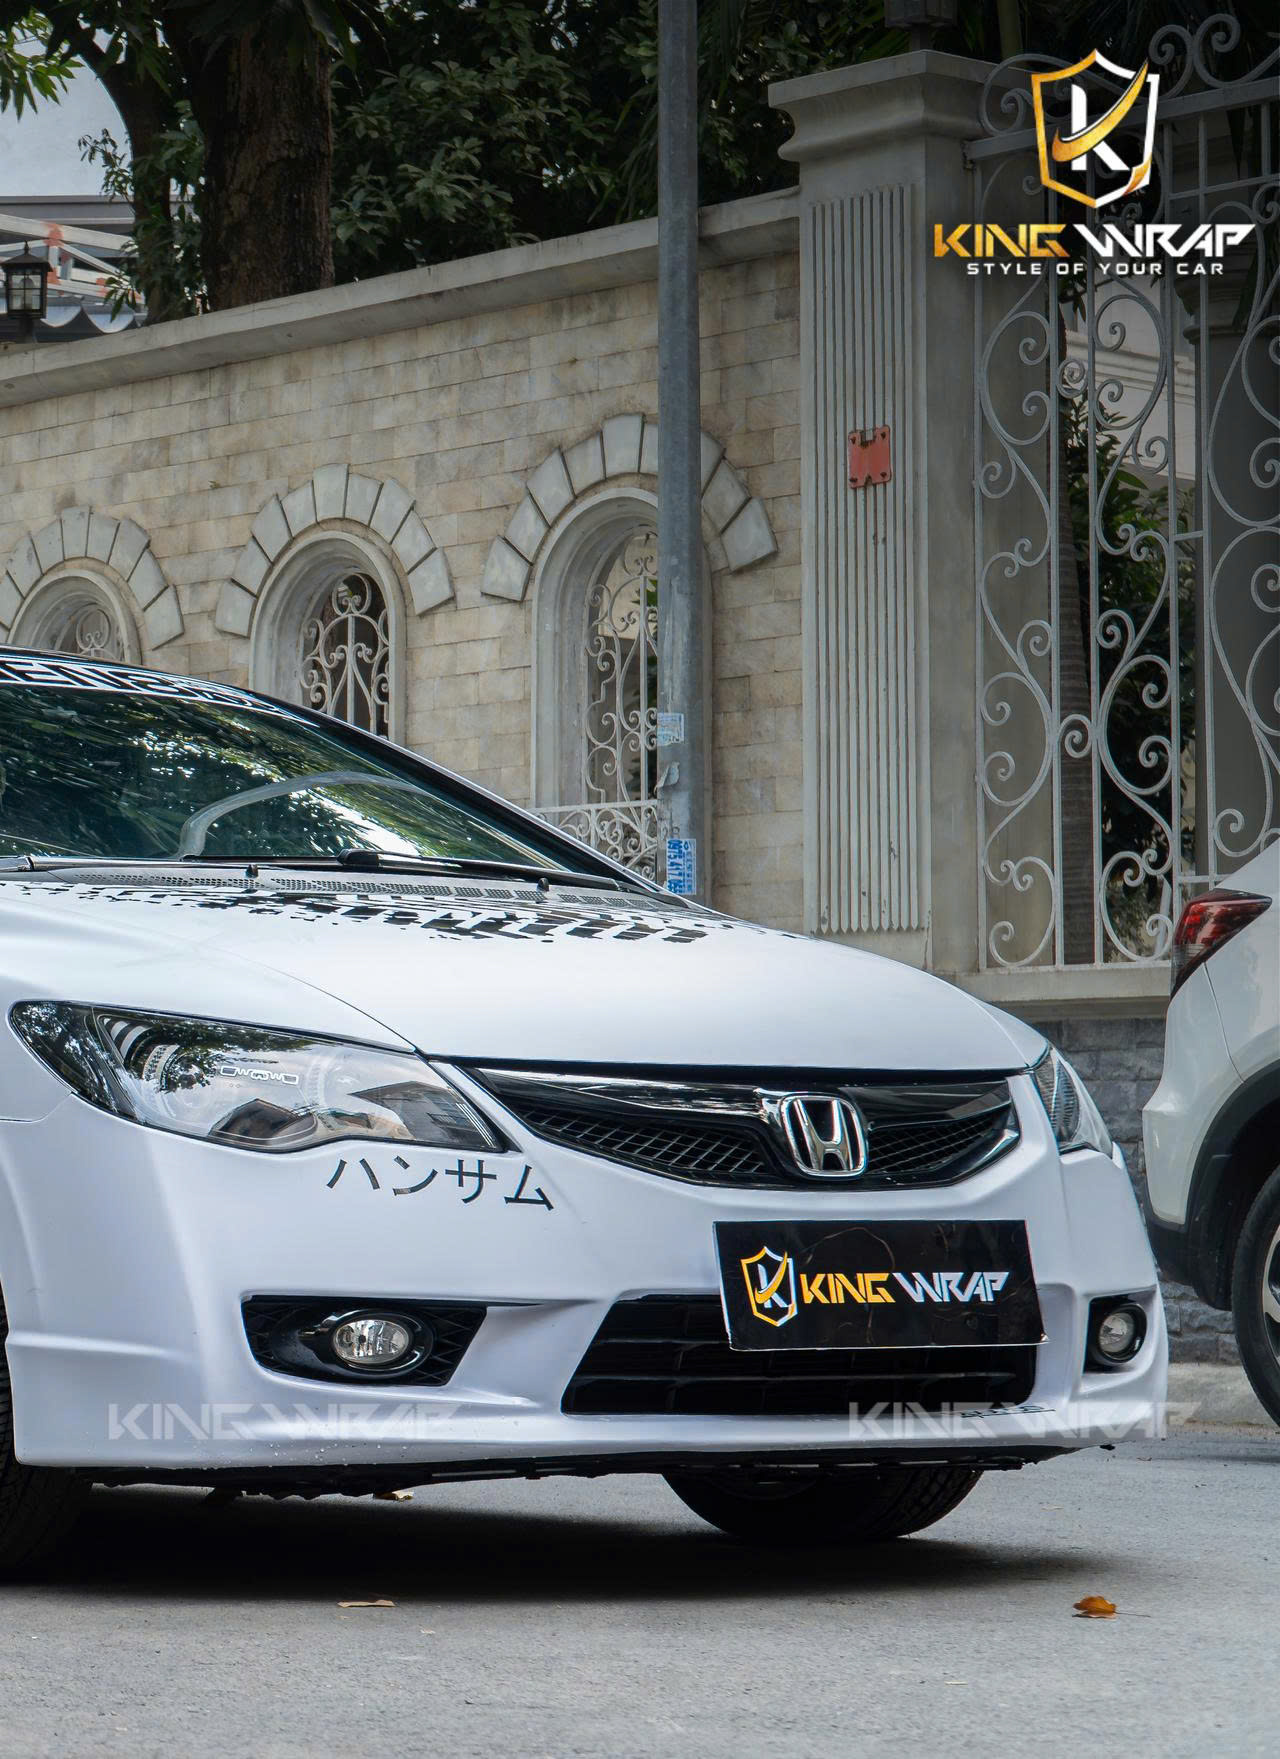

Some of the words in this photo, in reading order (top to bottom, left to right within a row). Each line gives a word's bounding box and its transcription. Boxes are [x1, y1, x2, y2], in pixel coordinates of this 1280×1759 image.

[326, 1156, 554, 1211] ハンサム
[800, 1272, 896, 1304] KING
[892, 1271, 1009, 1302] WRAP
